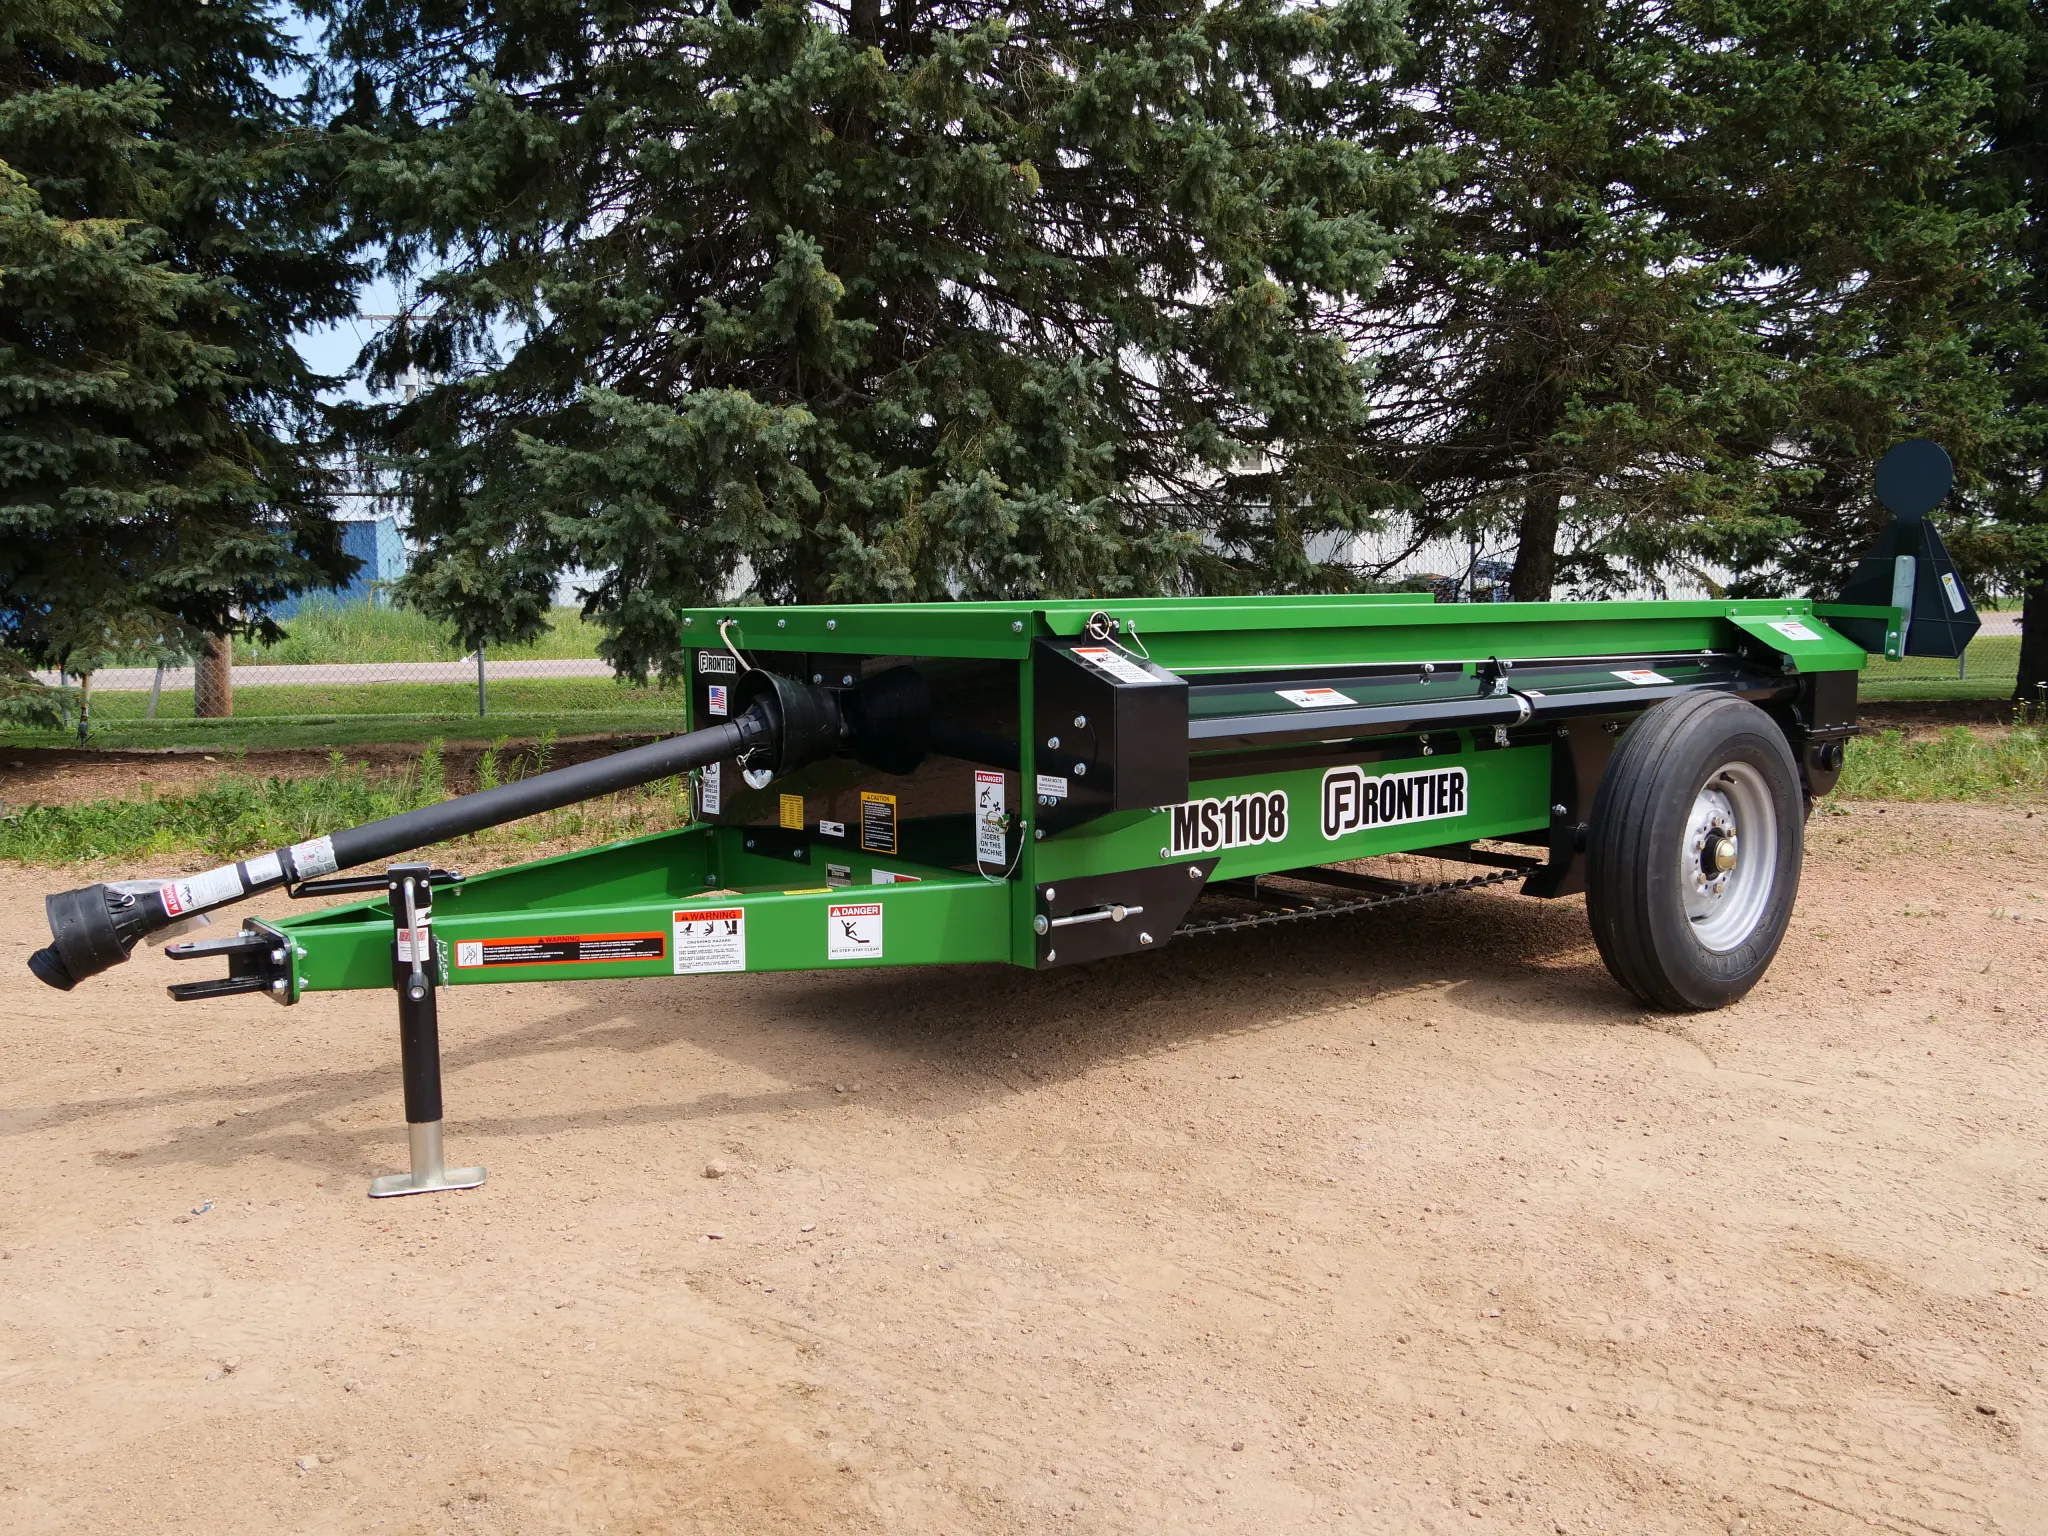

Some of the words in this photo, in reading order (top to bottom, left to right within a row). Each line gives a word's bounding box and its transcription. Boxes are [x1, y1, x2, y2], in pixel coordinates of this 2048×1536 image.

[699, 651, 736, 673] FRONTIER
[982, 774, 1003, 784] DANGER
[870, 794, 890, 803] CAUTION
[1323, 770, 1466, 836] FRONTIER
[1174, 794, 1286, 852] MS1108
[989, 841, 1001, 850] THIS
[979, 848, 1003, 857] MACHINE
[690, 911, 736, 921] WARNING
[841, 906, 879, 916] DANGER
[545, 935, 580, 943] WARNING
